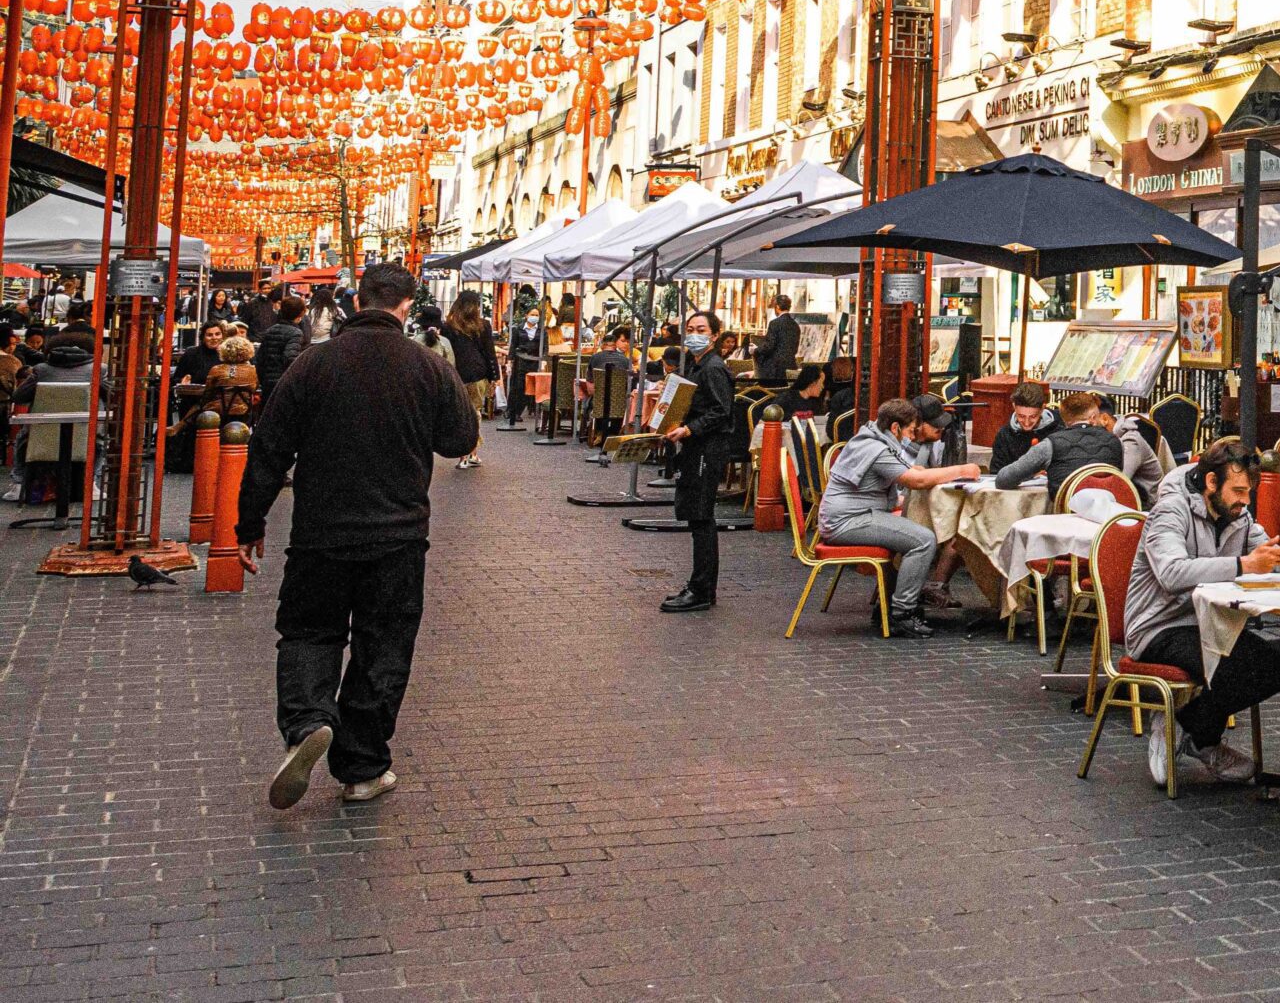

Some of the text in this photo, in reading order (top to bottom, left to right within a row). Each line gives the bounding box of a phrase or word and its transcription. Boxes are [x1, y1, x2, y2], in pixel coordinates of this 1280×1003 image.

[985, 90, 1034, 121] CANTONESE
[1043, 80, 1077, 106] PEKING
[1020, 123, 1036, 145] DIM
[1039, 119, 1059, 141] SUM
[1129, 173, 1176, 197] LONDON
